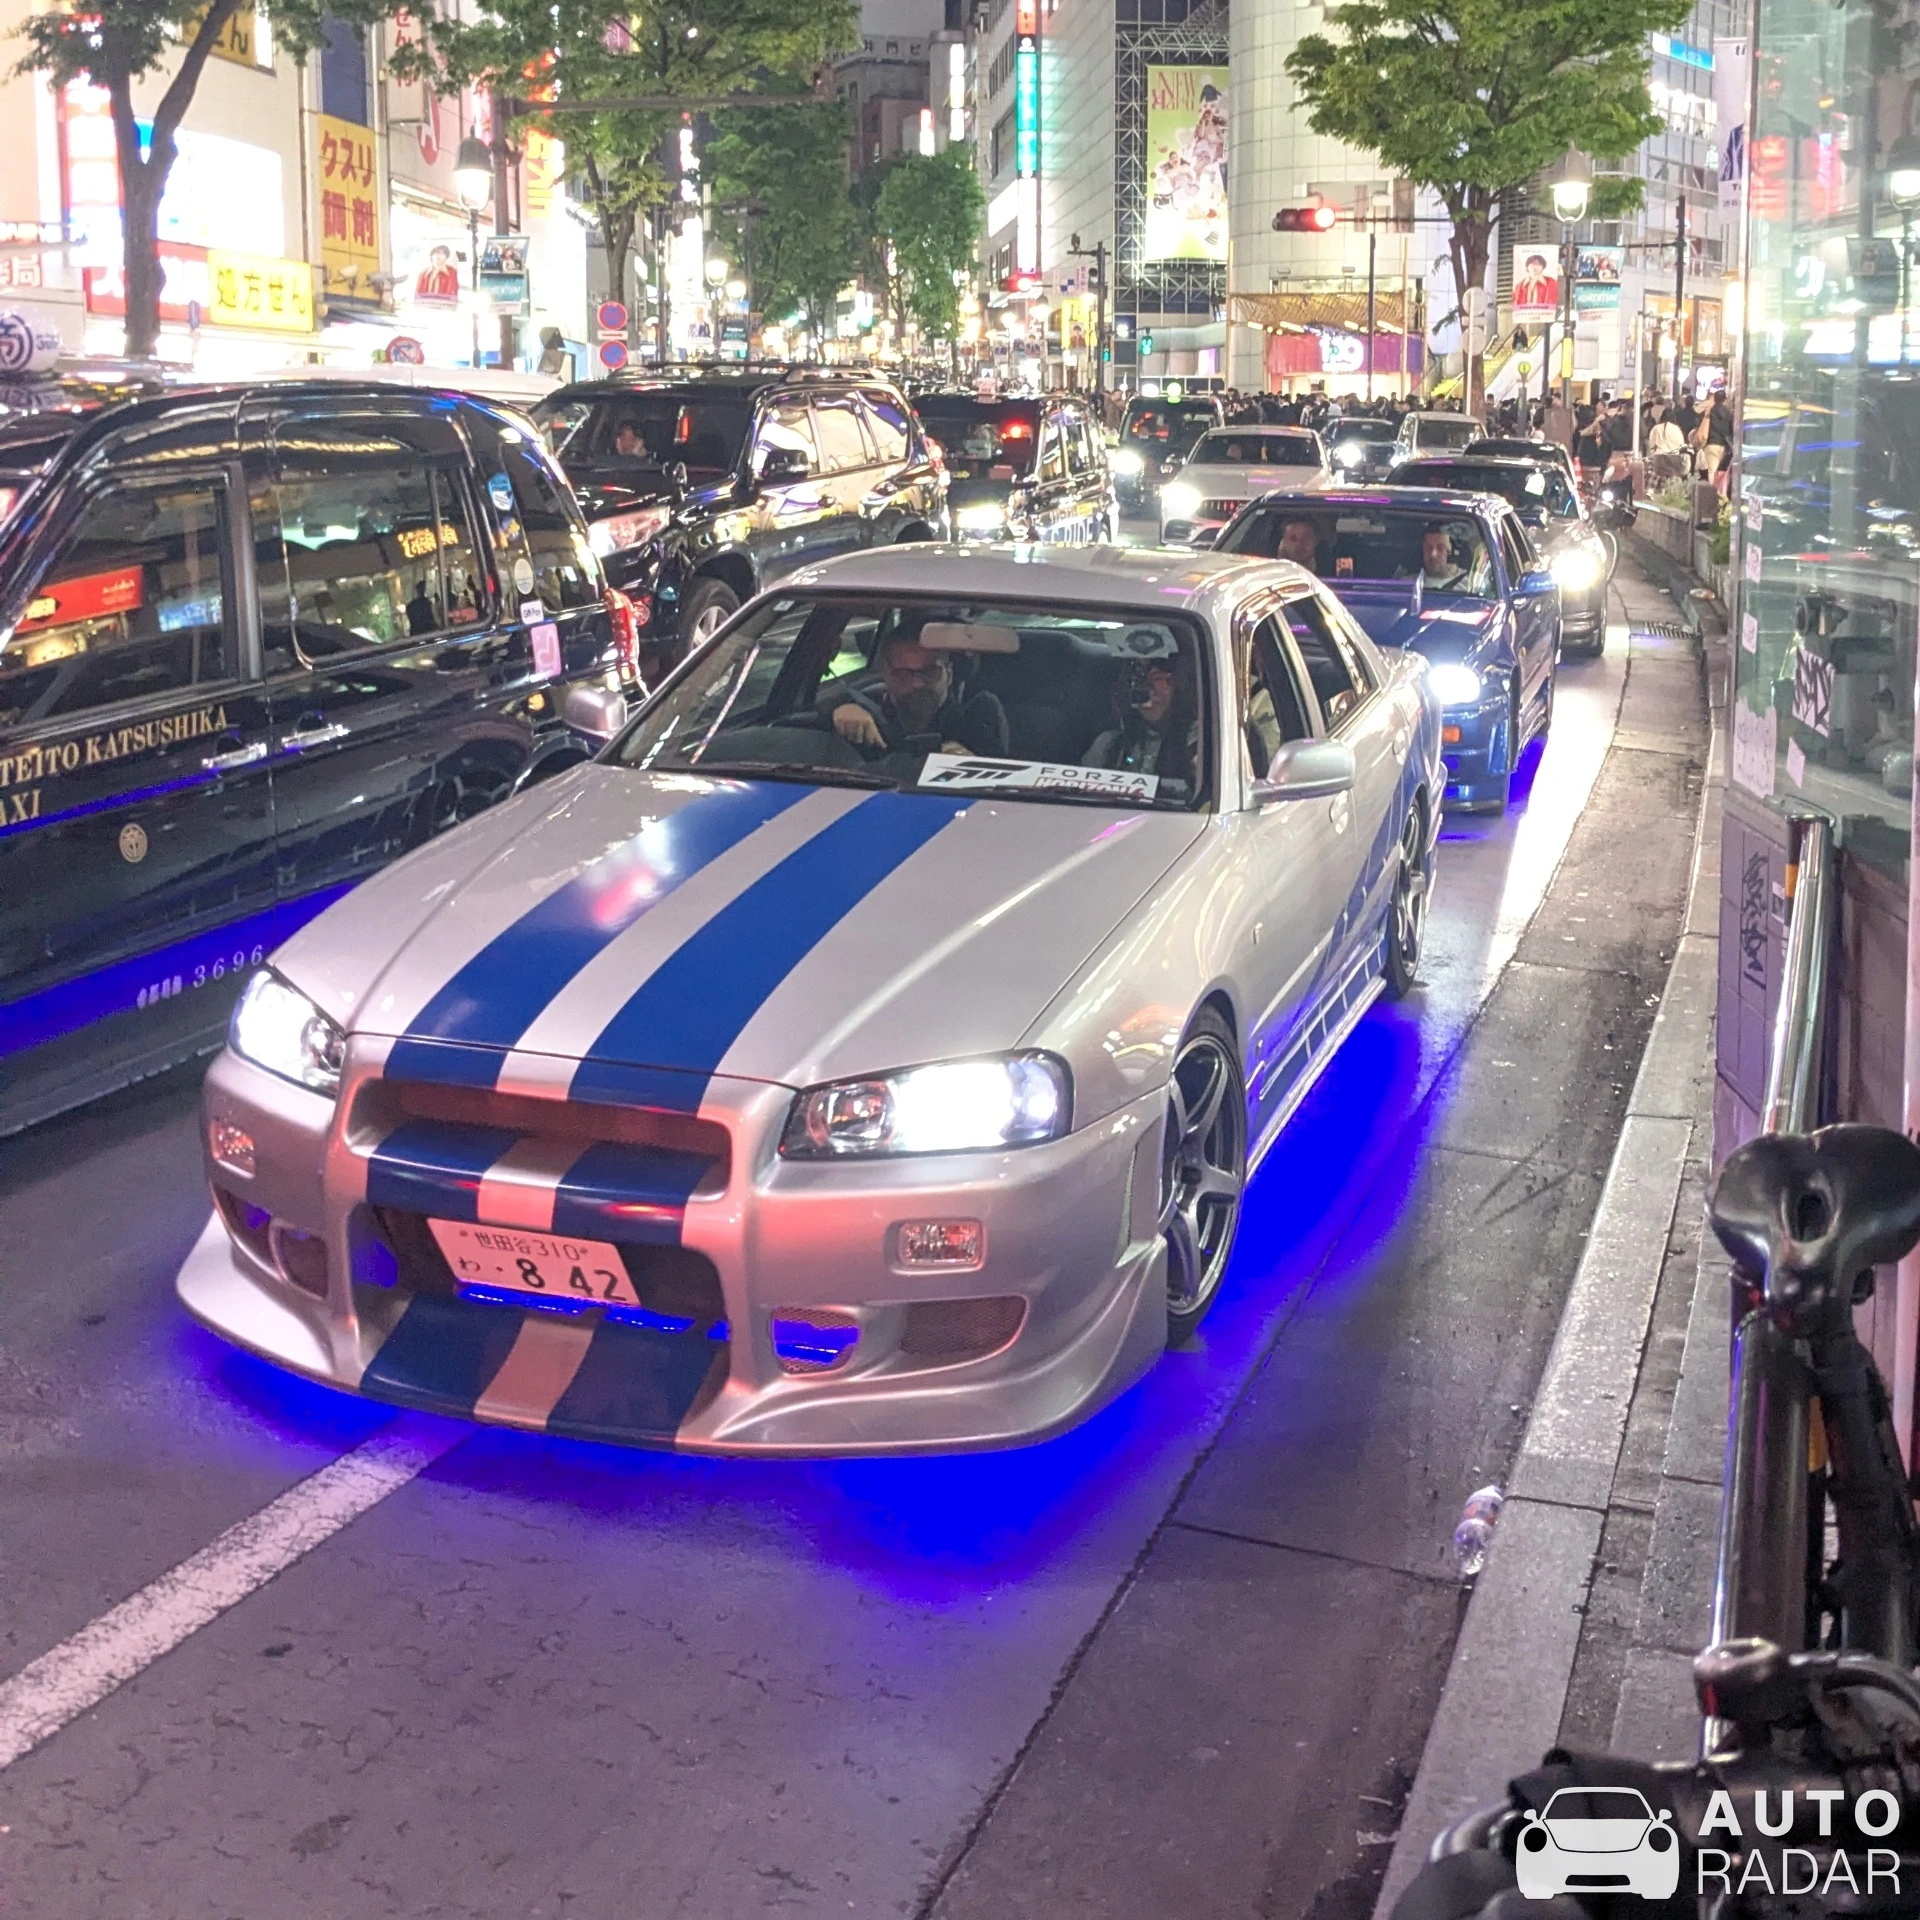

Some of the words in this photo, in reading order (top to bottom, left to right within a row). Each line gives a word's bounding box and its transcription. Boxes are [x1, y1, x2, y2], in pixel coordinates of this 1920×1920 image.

[321, 130, 373, 188] クスリ
[323, 190, 374, 247] 調剤
[217, 266, 306, 315] 処方せん
[0, 742, 80, 787] TEITO
[85, 705, 228, 766] KATSUSHIKA
[1040, 767, 1149, 787] FORZA
[193, 944, 263, 989] 3696
